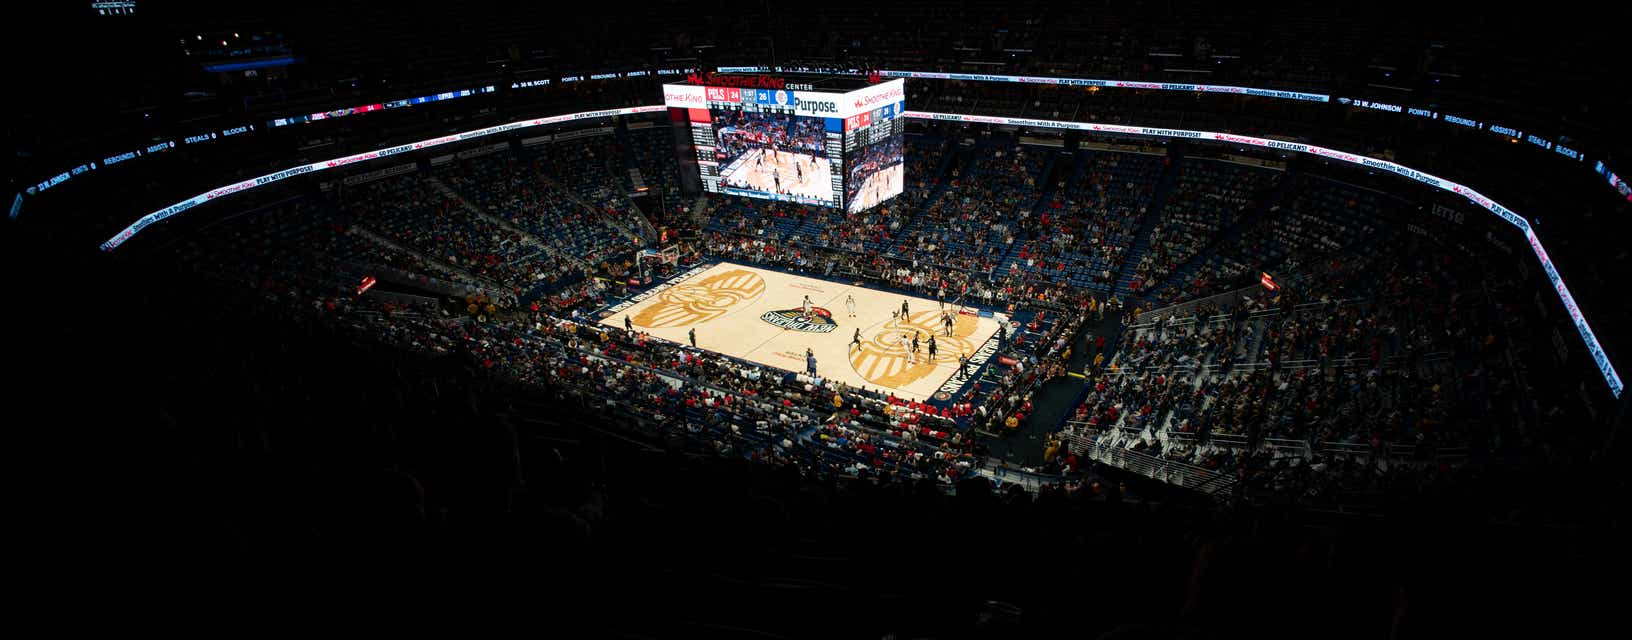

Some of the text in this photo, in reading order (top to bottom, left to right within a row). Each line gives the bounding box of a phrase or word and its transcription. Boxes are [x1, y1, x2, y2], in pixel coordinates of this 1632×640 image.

[758, 74, 785, 89] KING
[685, 93, 703, 103] KING
[708, 88, 725, 100] PELS
[864, 89, 902, 106] SMOOTHIE KING
[1246, 88, 1276, 96] Smoothies
[794, 97, 838, 114] Purpose.
[1370, 102, 1402, 112] JOHNSON
[848, 115, 860, 130] PELS
[459, 129, 486, 140] Smoothies
[486, 127, 499, 135] With
[1408, 108, 1431, 117] POINTS
[1444, 114, 1476, 127] REBOUNDS
[1490, 125, 1516, 137] ASSISTS
[1528, 134, 1546, 147] STEALS
[1555, 144, 1577, 159] BLOCKS
[104, 152, 135, 165] REBOUNDS
[147, 142, 168, 153] ASSISTS
[185, 134, 209, 144] STEALS
[223, 126, 247, 136] BLOCKS
[387, 144, 413, 155] PELICANS!
[1276, 142, 1307, 151] PELICANS!
[1362, 158, 1396, 172] Smoothies
[1396, 166, 1410, 176] With
[256, 165, 313, 185] PLAY WITH PURPOSE!
[154, 210, 168, 220] With
[762, 312, 835, 334] NEW ORLEANS
